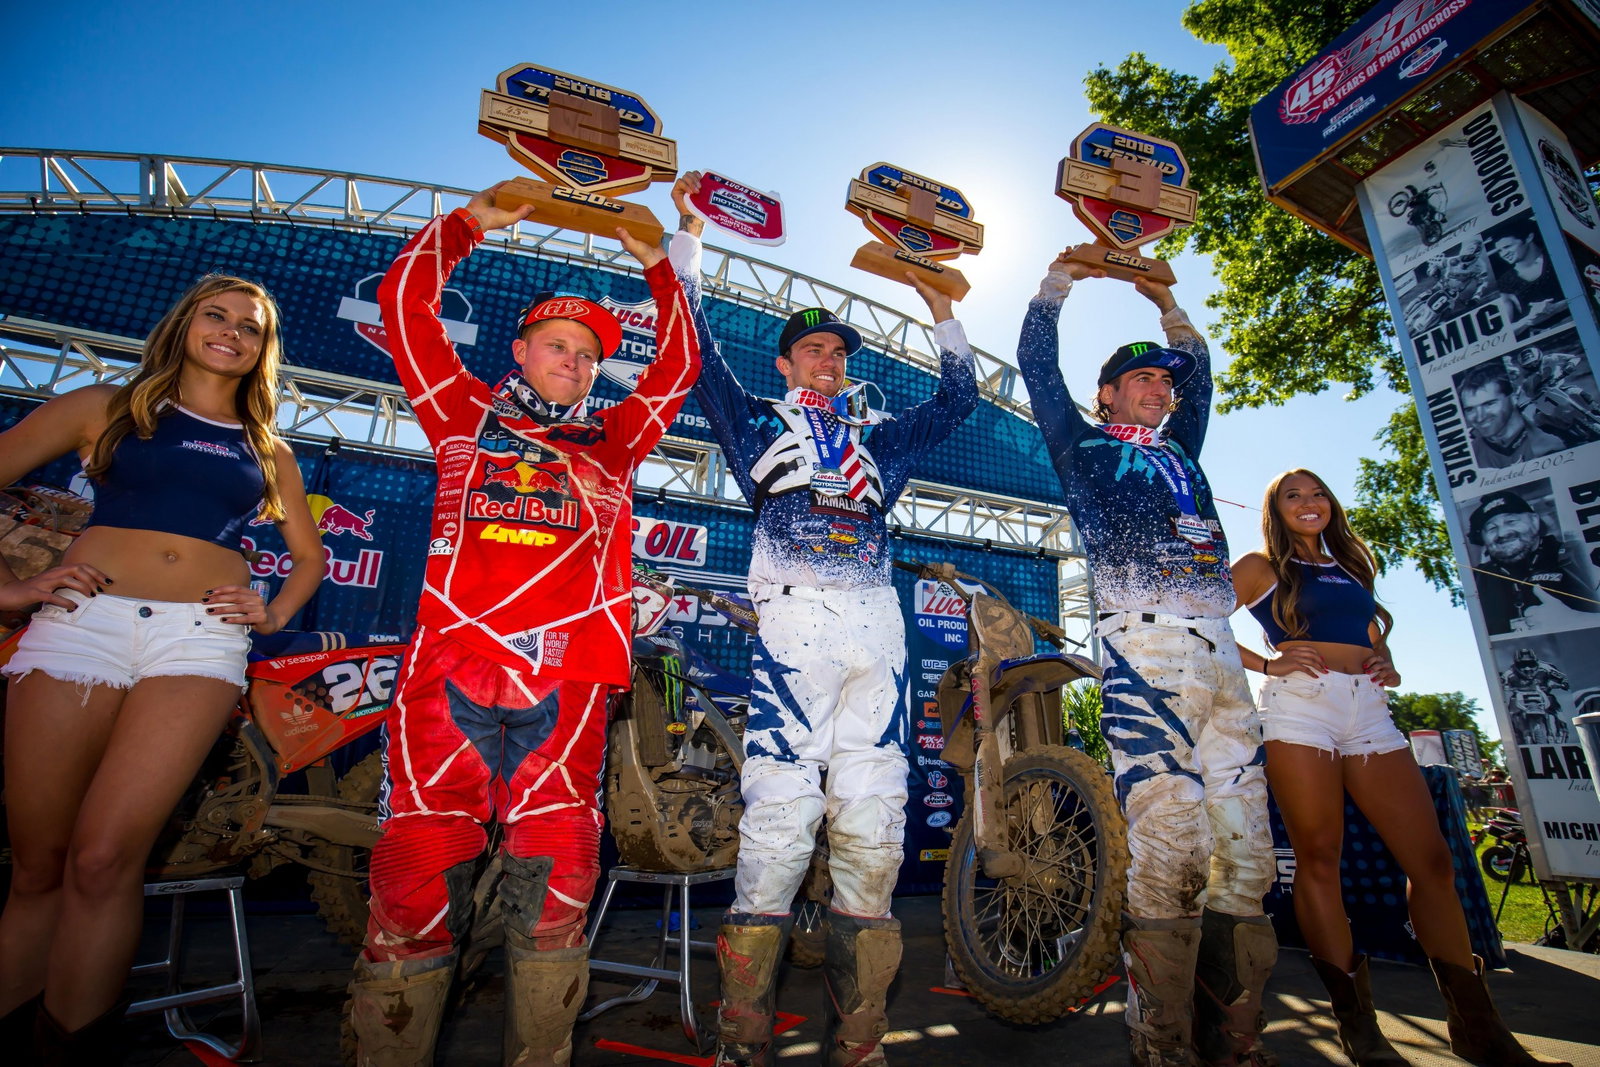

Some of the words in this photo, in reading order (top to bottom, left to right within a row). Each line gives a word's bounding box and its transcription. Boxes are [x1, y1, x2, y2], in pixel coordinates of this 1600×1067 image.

[1322, 93, 1336, 110] 45
[1335, 71, 1366, 98] YEARS
[1366, 60, 1380, 77] OF
[1379, 45, 1400, 68] PRO
[1401, 0, 1467, 51] MOTOCROSS
[554, 76, 612, 102] 2018
[1290, 67, 1336, 111] 45
[1113, 135, 1155, 155] 2018
[1462, 110, 1525, 217] DOMOKOS
[725, 181, 750, 194] LUCAS
[749, 191, 761, 199] OIL
[901, 173, 942, 193] 2018
[553, 185, 622, 210] 250cc
[712, 195, 765, 221] MOTOCROSS
[721, 191, 747, 204] LUCAS
[747, 201, 760, 210] OIL
[896, 250, 945, 272] 250cc
[1106, 251, 1152, 270] 250cc
[1414, 304, 1505, 366] EMIG
[1428, 346, 1469, 375] Inducted
[1426, 387, 1477, 488] STANTON
[1480, 463, 1526, 488] Inducted
[1529, 451, 1575, 474] 2002
[811, 481, 849, 489] MOTOCROSS
[469, 491, 524, 520] Red
[523, 496, 578, 529] Bull
[815, 493, 869, 516] YAMALUBE
[644, 522, 699, 561] OIL
[918, 618, 935, 628] OIL
[937, 620, 968, 631] PRODU
[545, 631, 557, 640] FOR
[559, 632, 570, 641] THE
[944, 633, 964, 643] INC.
[287, 653, 330, 666] seaspan
[921, 659, 948, 671] WPS
[355, 706, 384, 718] MOTOREX
[284, 723, 319, 737] adidas
[1449, 735, 1467, 771] ROCK
[1460, 733, 1481, 773] RIVER
